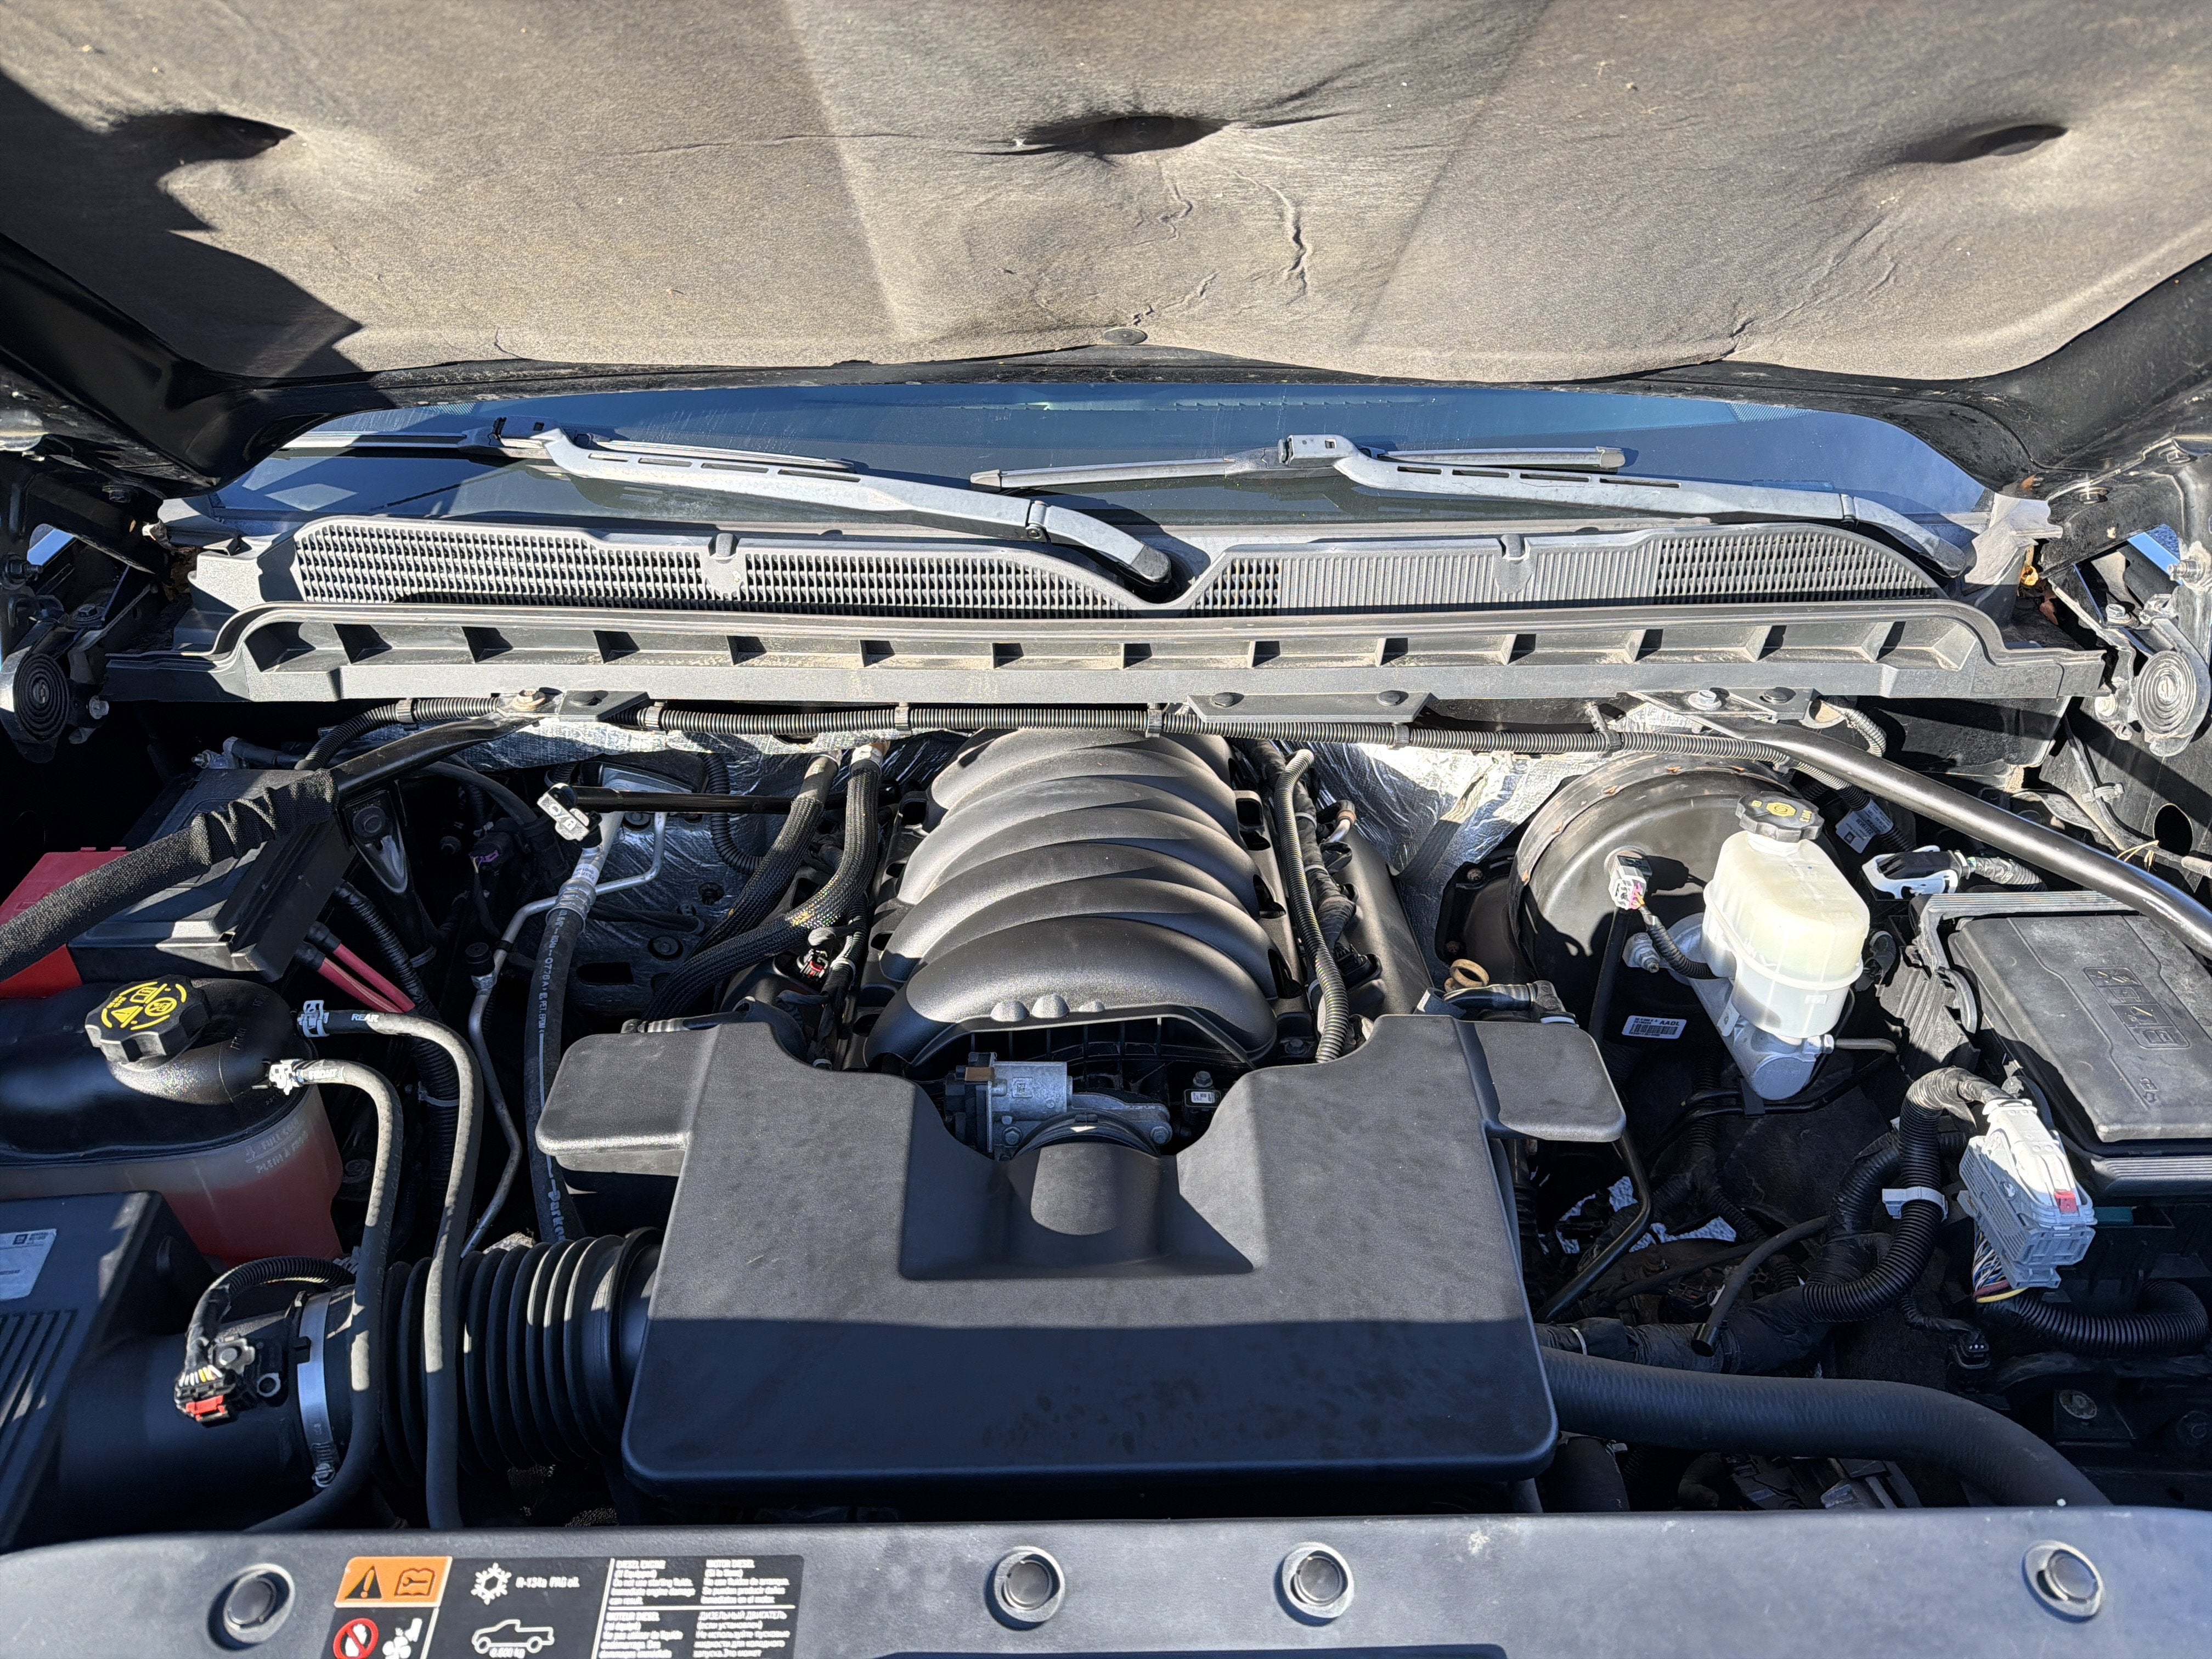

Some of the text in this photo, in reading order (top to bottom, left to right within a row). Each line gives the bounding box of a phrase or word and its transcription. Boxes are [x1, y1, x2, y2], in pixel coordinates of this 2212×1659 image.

[351, 1013, 379, 1023] REAR
[308, 1069, 338, 1080] FRONT
[261, 1133, 282, 1150] FULL
[255, 1154, 284, 1174] PLEIN
[516, 1577, 547, 1588] R-134a
[549, 1576, 567, 1588] PAG
[514, 1647, 525, 1658] kg
